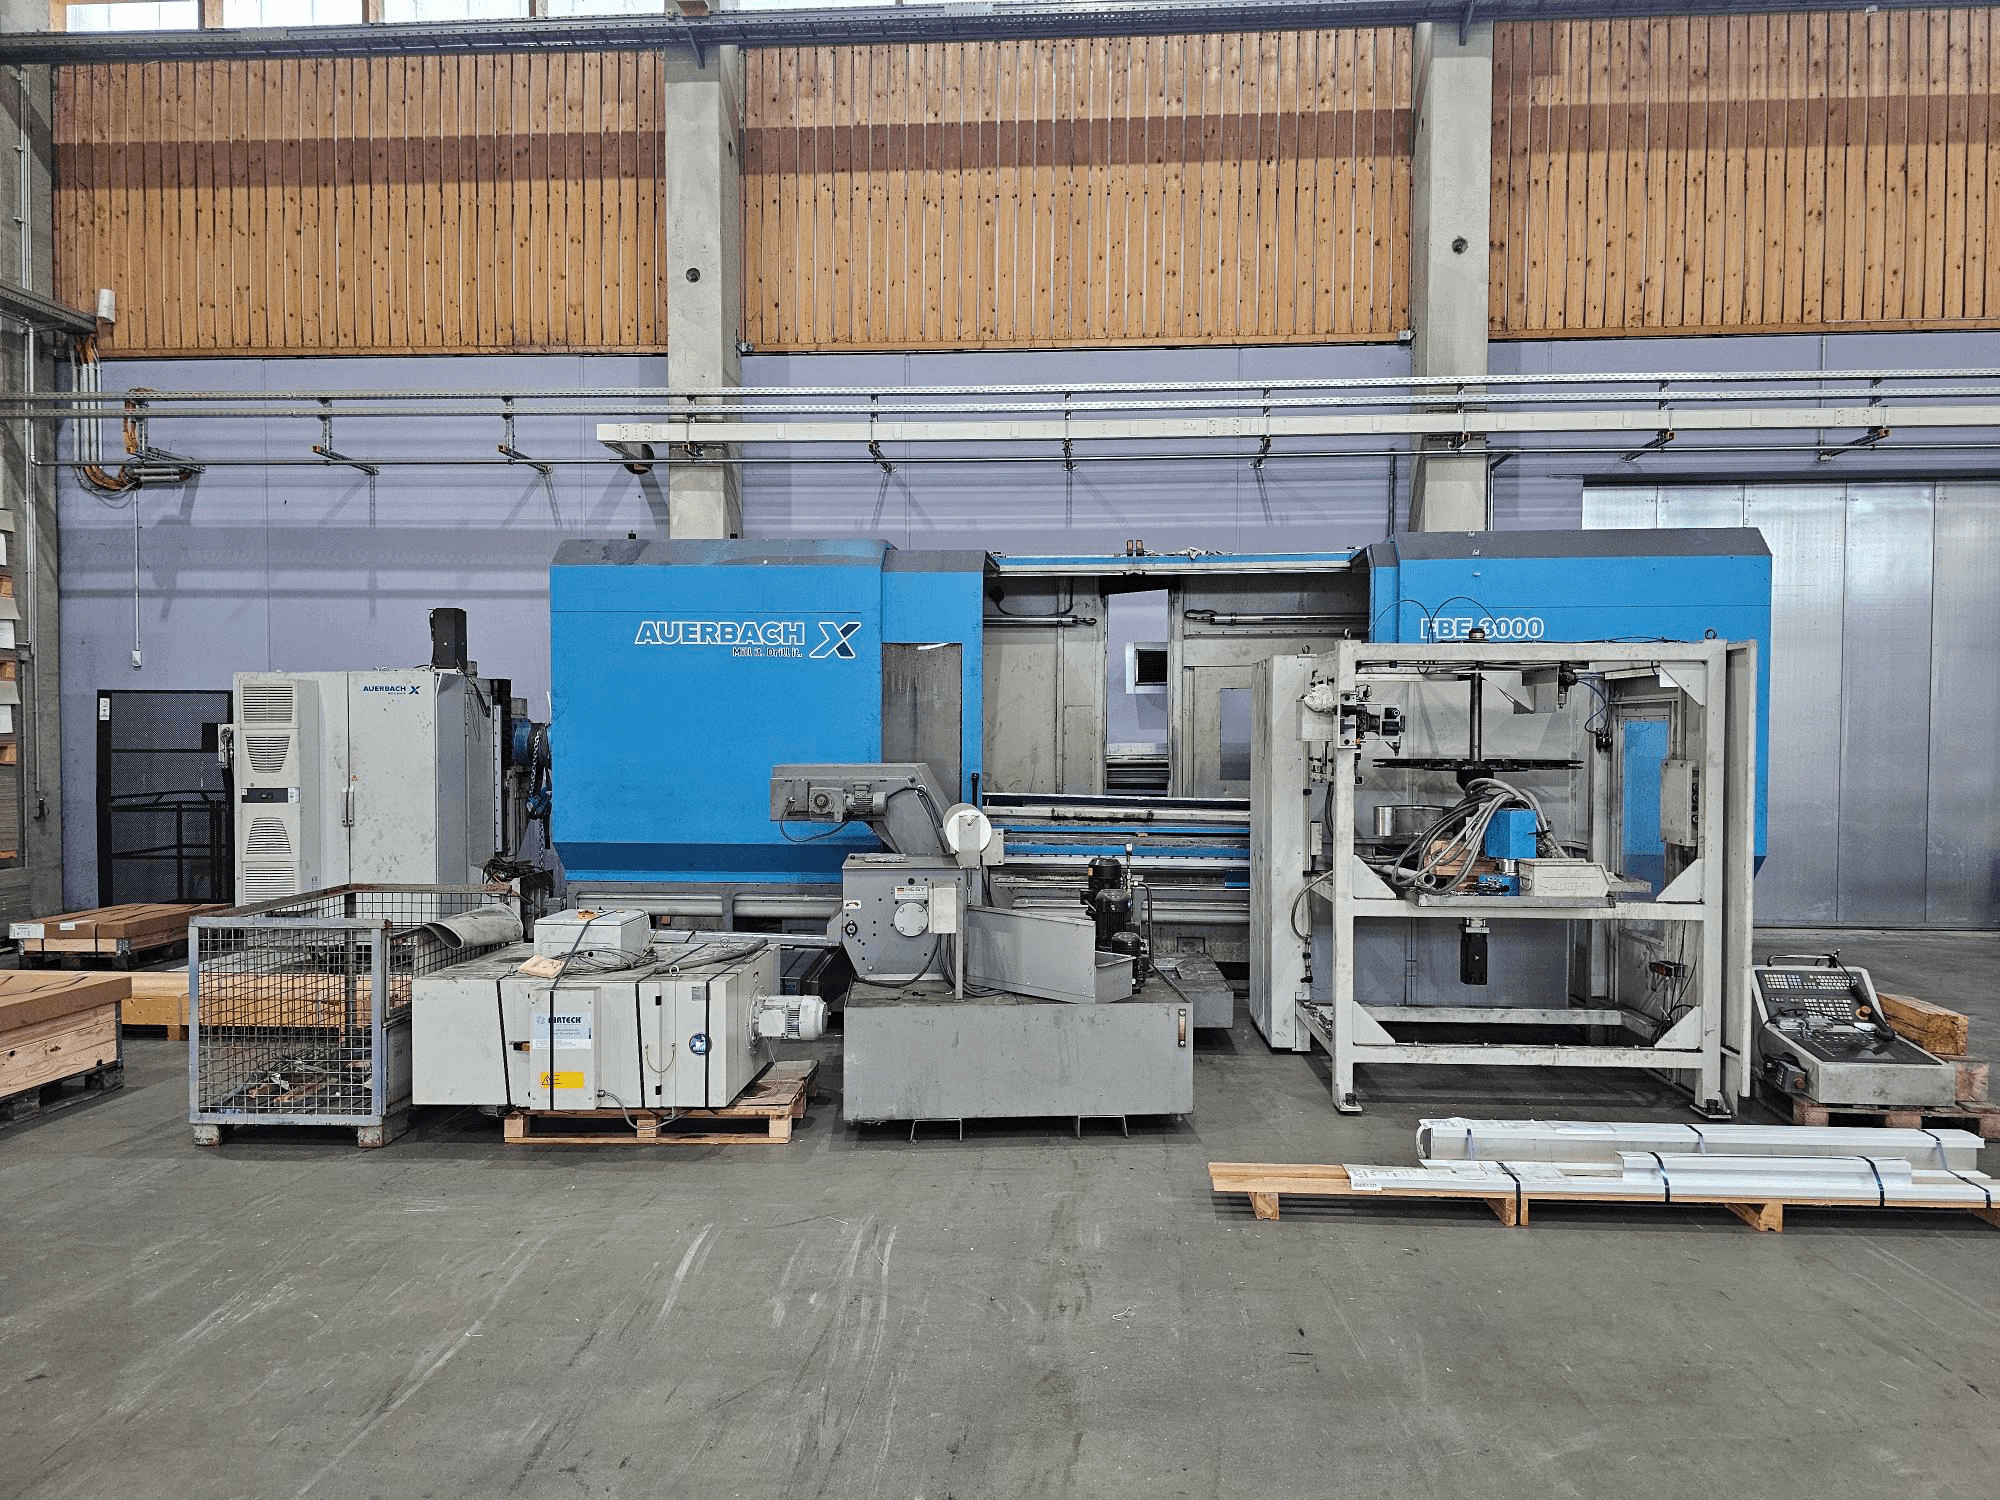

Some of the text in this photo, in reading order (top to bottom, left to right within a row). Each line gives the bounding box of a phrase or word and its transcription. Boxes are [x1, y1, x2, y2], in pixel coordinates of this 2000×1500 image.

[634, 621, 805, 646] AUERBACH
[1420, 617, 1545, 639] FBE 3000
